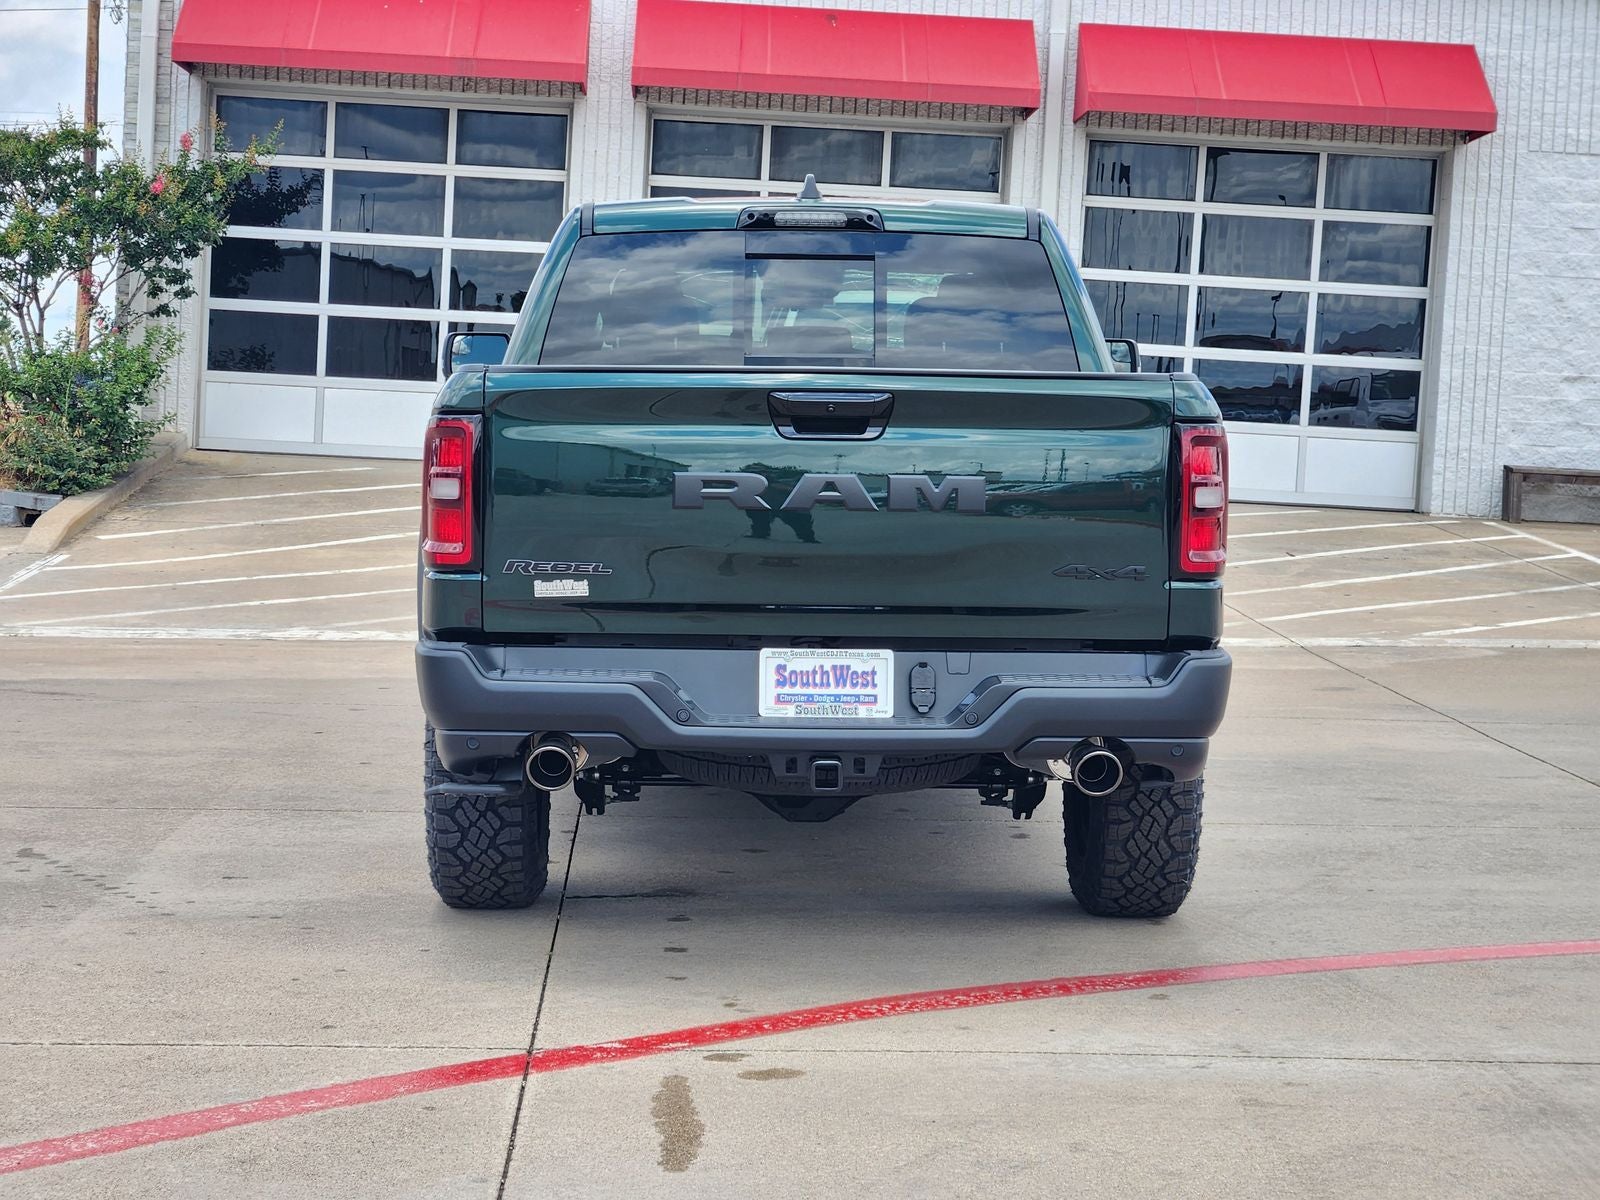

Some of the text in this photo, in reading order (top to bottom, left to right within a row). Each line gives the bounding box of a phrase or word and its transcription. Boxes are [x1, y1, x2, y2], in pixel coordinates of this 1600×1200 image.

[673, 471, 987, 512] RAM
[502, 559, 612, 575] REBEL
[774, 664, 878, 690] SouthWest
[780, 694, 875, 703] Chrysler Dodge Jeep Ram
[795, 704, 859, 716] SouthWest
